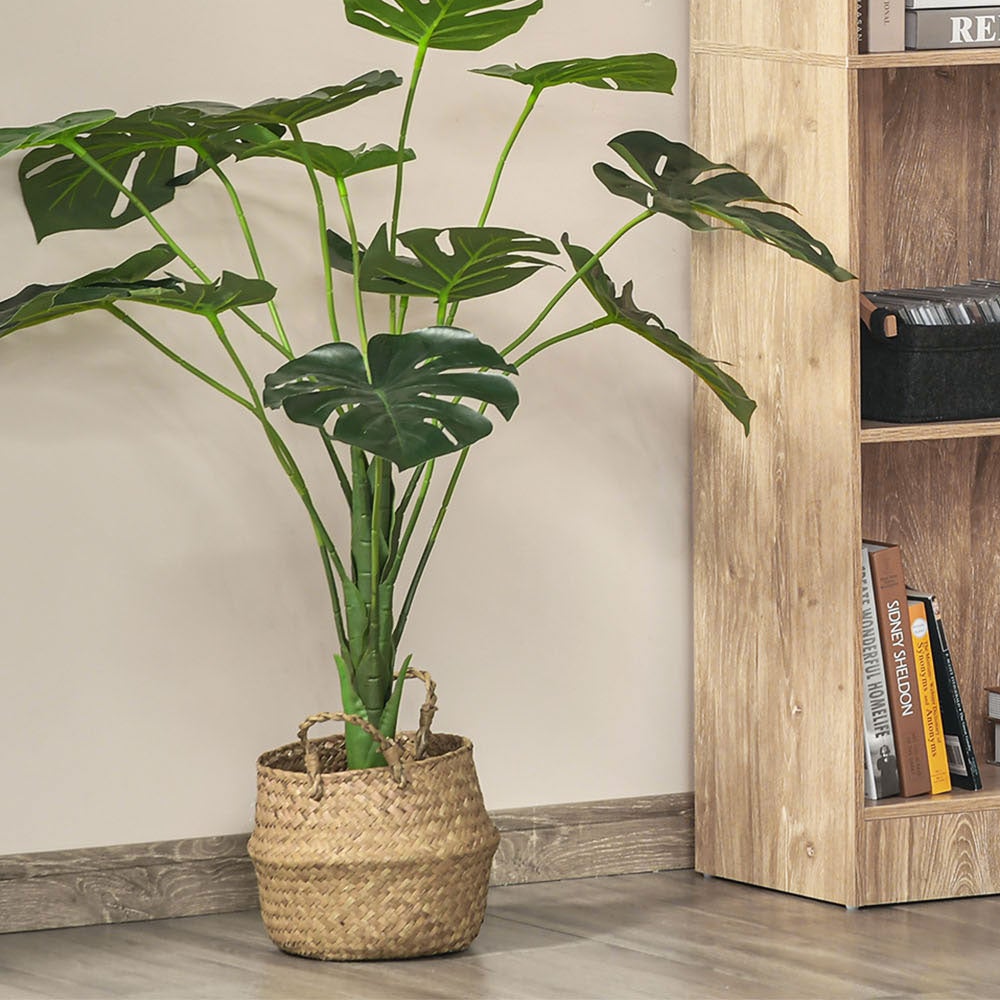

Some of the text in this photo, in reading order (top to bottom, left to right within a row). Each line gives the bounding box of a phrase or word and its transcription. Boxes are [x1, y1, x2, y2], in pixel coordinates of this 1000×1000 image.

[862, 606, 881, 681] WONDERFUL
[886, 599, 905, 648] SIDNEY
[867, 681, 891, 739] HOMELIFE
[893, 650, 913, 717] SHELDON
[916, 641, 928, 692] Synonyms
[926, 708, 937, 758] Antonyms
